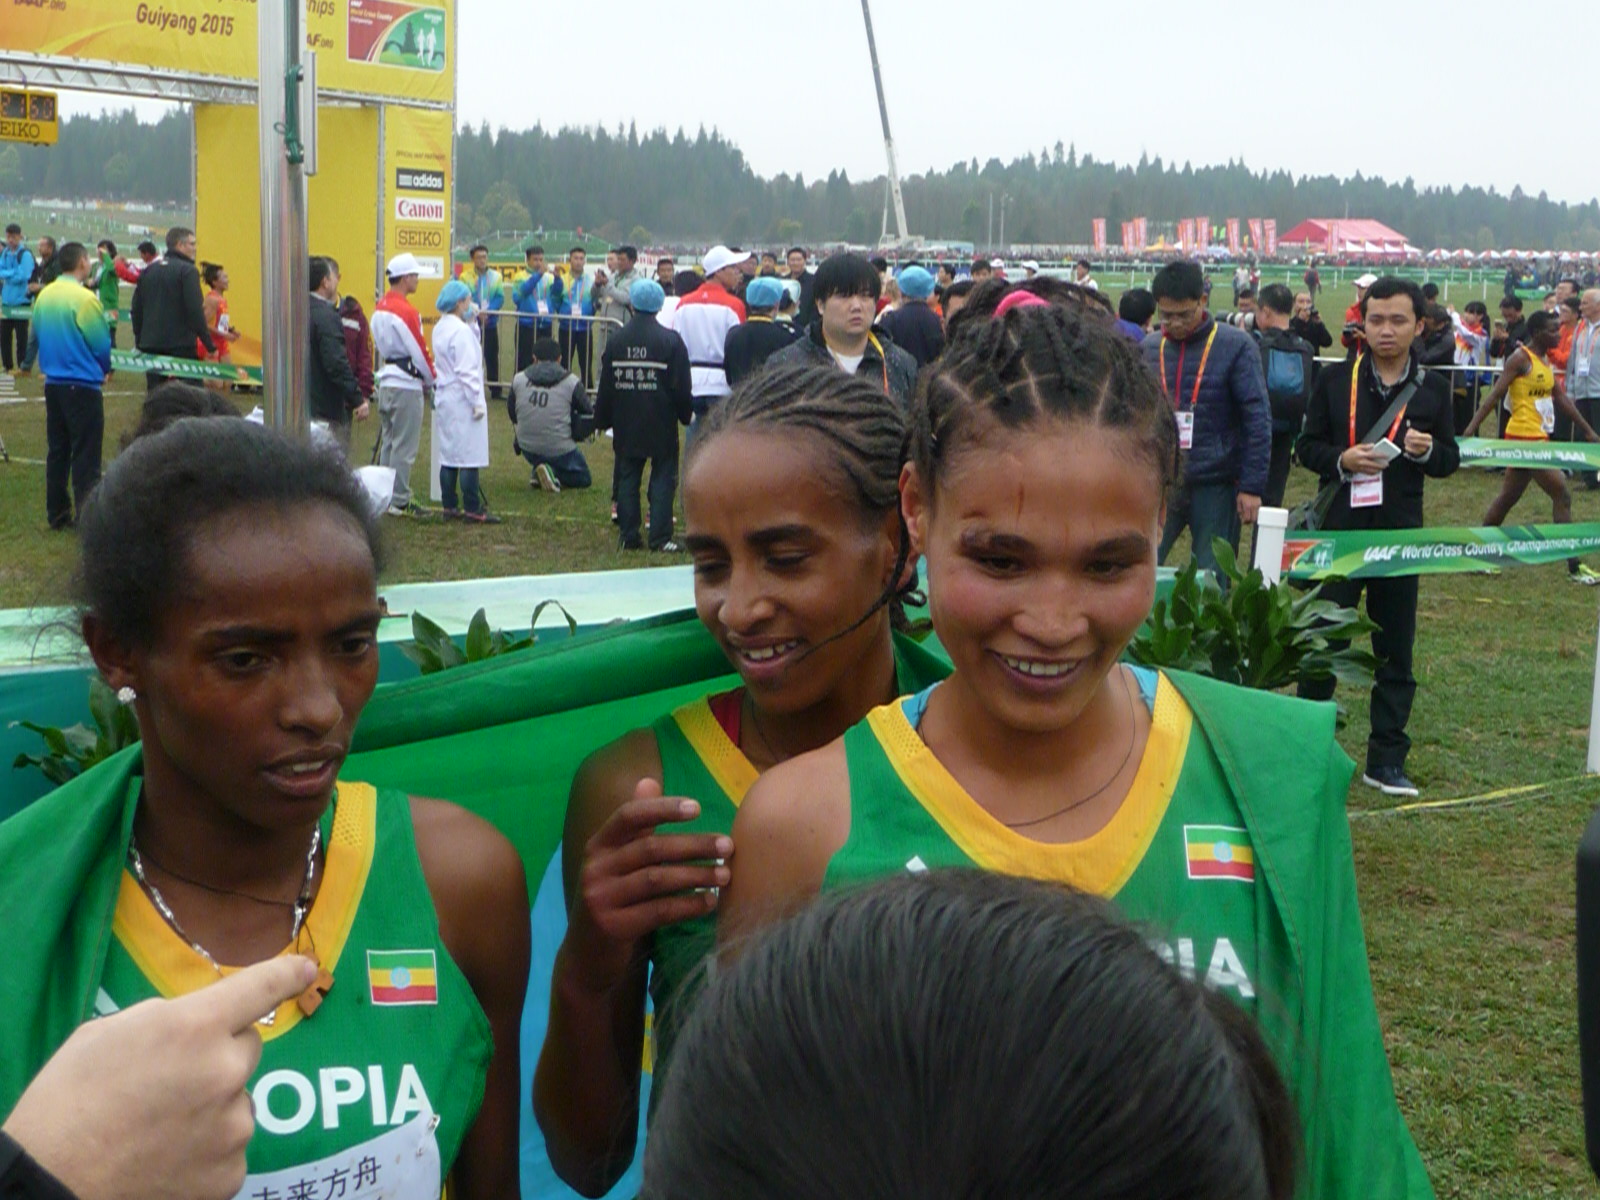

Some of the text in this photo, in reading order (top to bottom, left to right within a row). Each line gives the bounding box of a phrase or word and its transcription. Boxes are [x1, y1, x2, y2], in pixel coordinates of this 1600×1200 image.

[136, 3, 235, 36] Guiyang 2015
[413, 173, 442, 188] adidas
[398, 199, 443, 219] Canon
[398, 229, 442, 247] SEIKO
[627, 346, 647, 359] 120
[529, 390, 549, 408] 40
[1363, 544, 1400, 561] IAAF
[1402, 545, 1434, 560] World
[1434, 544, 1463, 557] Cross
[1465, 542, 1504, 557] Country
[251, 1063, 434, 1135] OPIA
